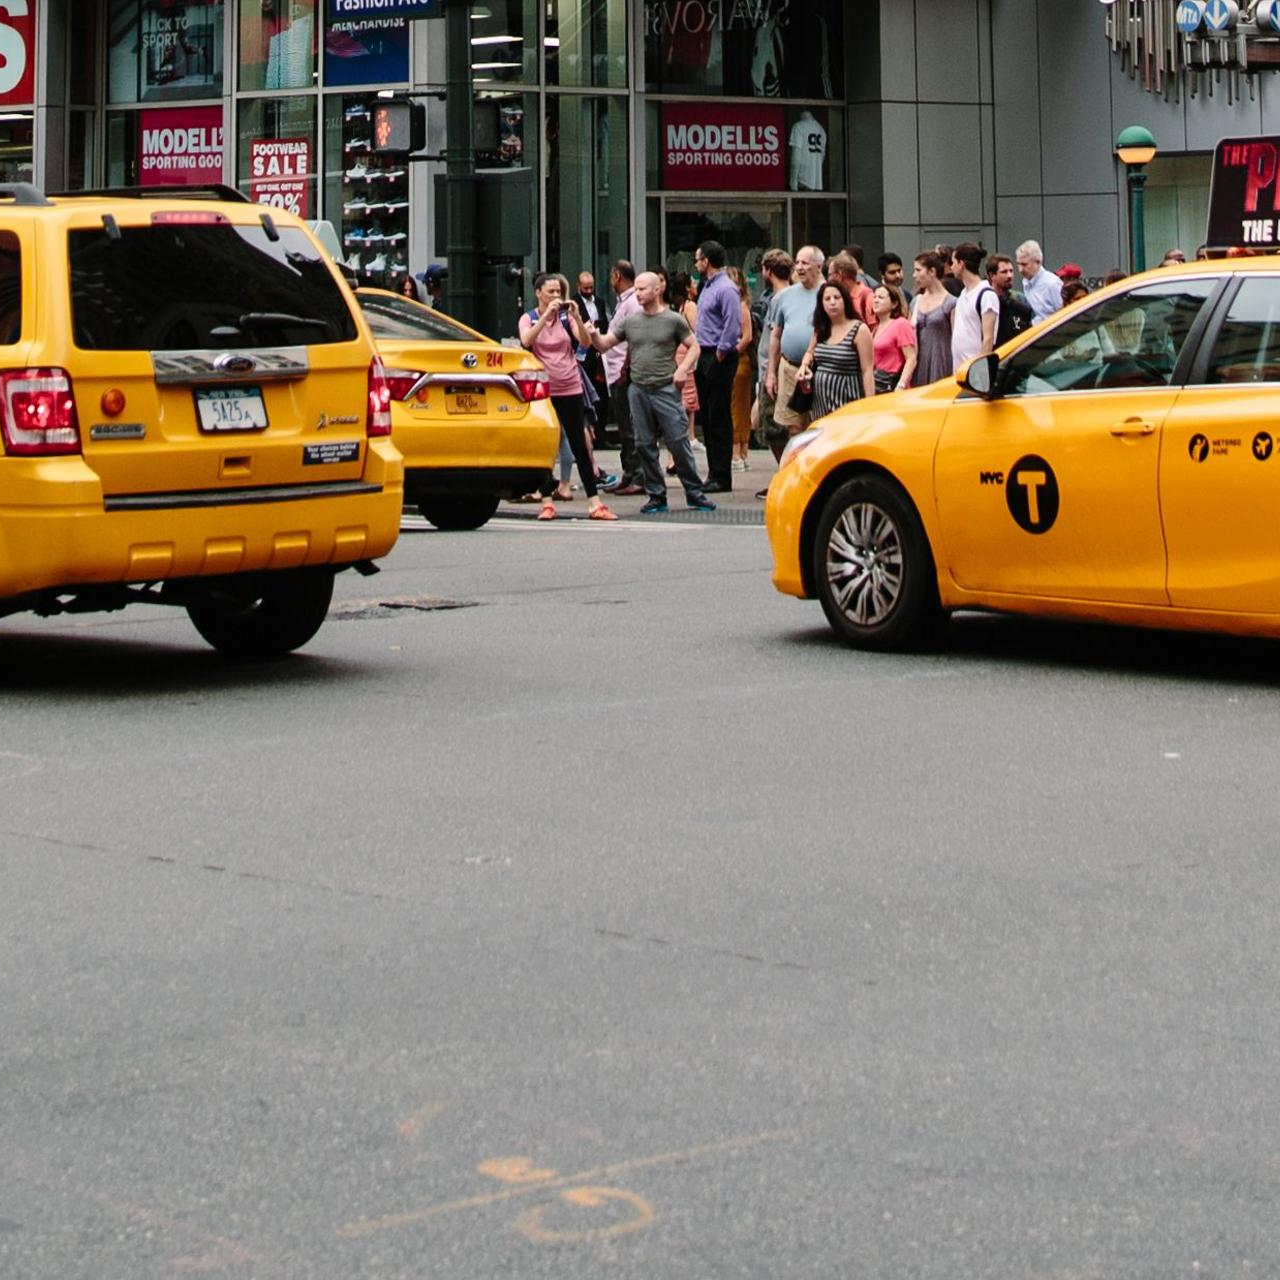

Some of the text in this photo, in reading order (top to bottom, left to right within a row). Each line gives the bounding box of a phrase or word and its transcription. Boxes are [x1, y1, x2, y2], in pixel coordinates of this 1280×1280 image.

[142, 32, 178, 49] SPORT
[667, 123, 779, 152] MODELL'S
[253, 142, 308, 156] FOOTWEAR
[1223, 144, 1248, 167] THE
[142, 155, 197, 169] SPORTING
[253, 155, 307, 176] SALE
[667, 152, 780, 166] SPORTING GOODS
[1242, 219, 1273, 243] THE
[980, 471, 1003, 485] NYC
[1016, 470, 1046, 524] T
